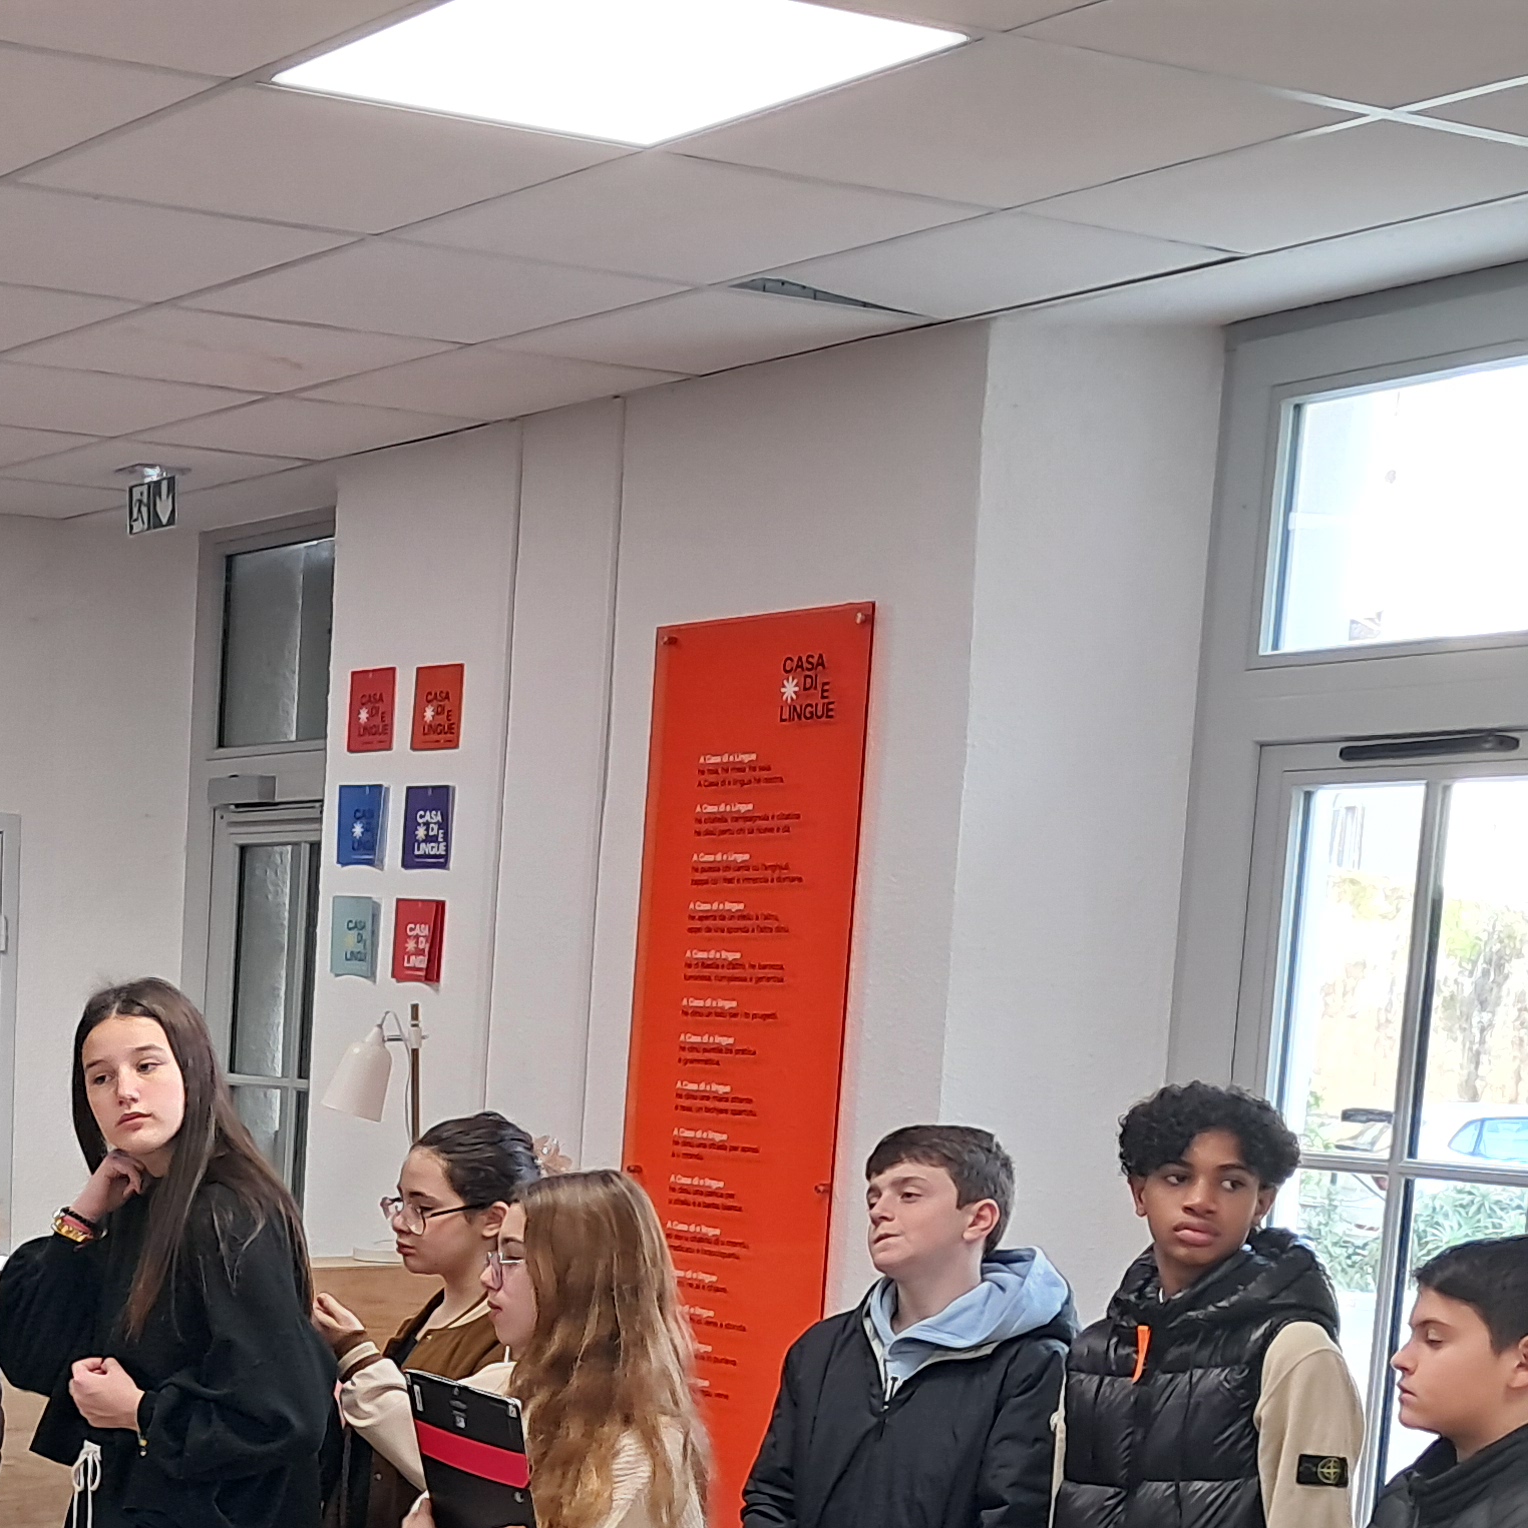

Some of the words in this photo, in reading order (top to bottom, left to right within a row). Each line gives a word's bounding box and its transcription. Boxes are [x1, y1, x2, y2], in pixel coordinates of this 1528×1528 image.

[783, 654, 826, 674] CASA
[803, 674, 818, 691] DI
[821, 682, 830, 699] E
[360, 692, 384, 705] CASA
[426, 690, 450, 702] CASA
[371, 706, 380, 717] DI
[381, 712, 386, 722] E
[436, 704, 445, 715] DI
[446, 710, 452, 721] E
[779, 701, 835, 723] LINGUE
[358, 724, 388, 736] LINGUE
[423, 723, 456, 735] LINGUE
[706, 755, 721, 763] Casa
[695, 805, 701, 813] A
[703, 804, 718, 813] Casa
[417, 810, 442, 822] CASA
[429, 824, 438, 835] DI
[438, 830, 444, 841] E
[414, 842, 446, 855] LINGUE
